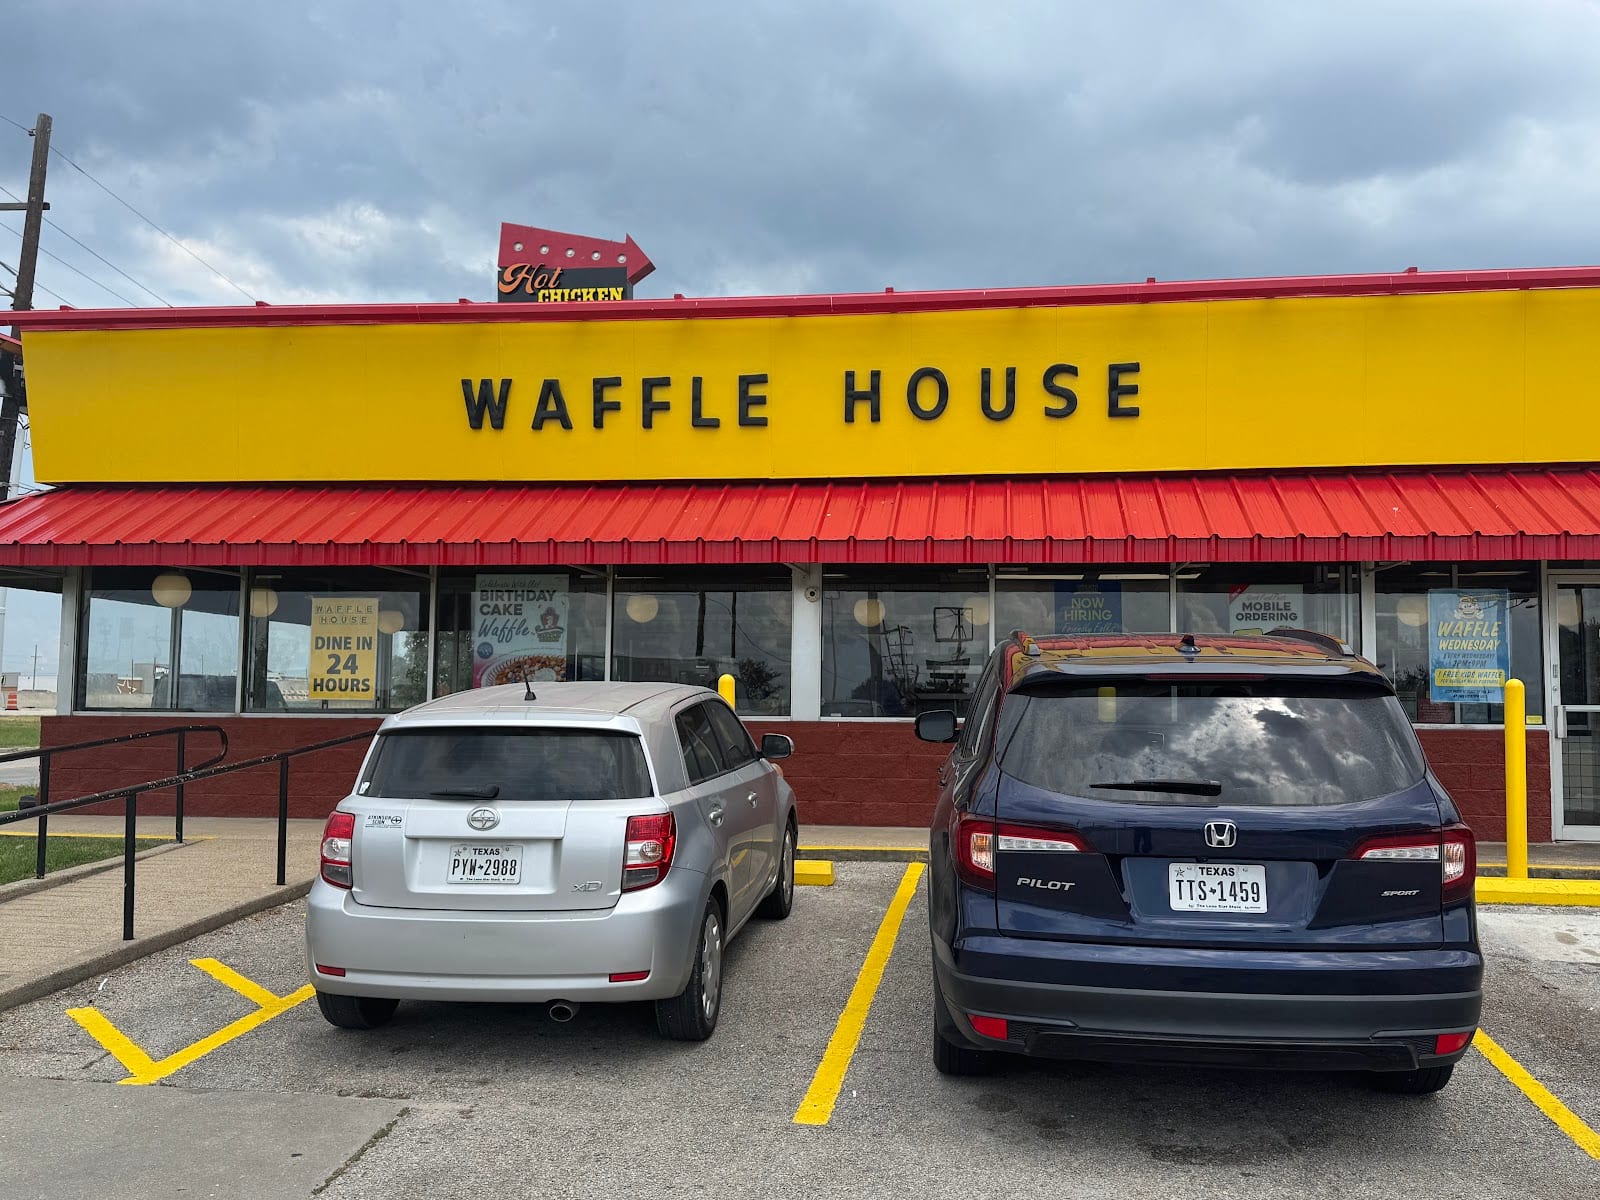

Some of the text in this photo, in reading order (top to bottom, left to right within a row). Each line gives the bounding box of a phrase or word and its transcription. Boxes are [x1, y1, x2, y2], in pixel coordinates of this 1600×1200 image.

[499, 263, 564, 294] Hot
[538, 287, 623, 302] CHICKEN
[461, 362, 1140, 430] WAFFLE HOUSE
[480, 589, 556, 602] BIRTHDAY
[316, 605, 373, 614] WAFFLE
[479, 603, 523, 616] CAKE
[1071, 598, 1104, 609] NOW
[1242, 601, 1291, 611] MOBILE
[320, 616, 368, 624] HOUSE
[1064, 610, 1112, 621] HIRING
[1235, 612, 1298, 621] ORDERING
[478, 618, 530, 644] Waffle
[1437, 621, 1501, 637] WAFFLE
[314, 636, 373, 650] DINE IN
[1439, 639, 1501, 651] WEDNESDAY
[326, 653, 358, 675] 24
[1443, 670, 1459, 678] FREE
[1461, 671, 1476, 679] KIDS
[1477, 671, 1503, 679] WAFFLE
[313, 678, 371, 692] HOURS
[472, 848, 500, 856] TEXAS
[1198, 866, 1235, 876] TEXAS
[1016, 877, 1076, 891] PILOT
[1381, 889, 1420, 897] SPORT
